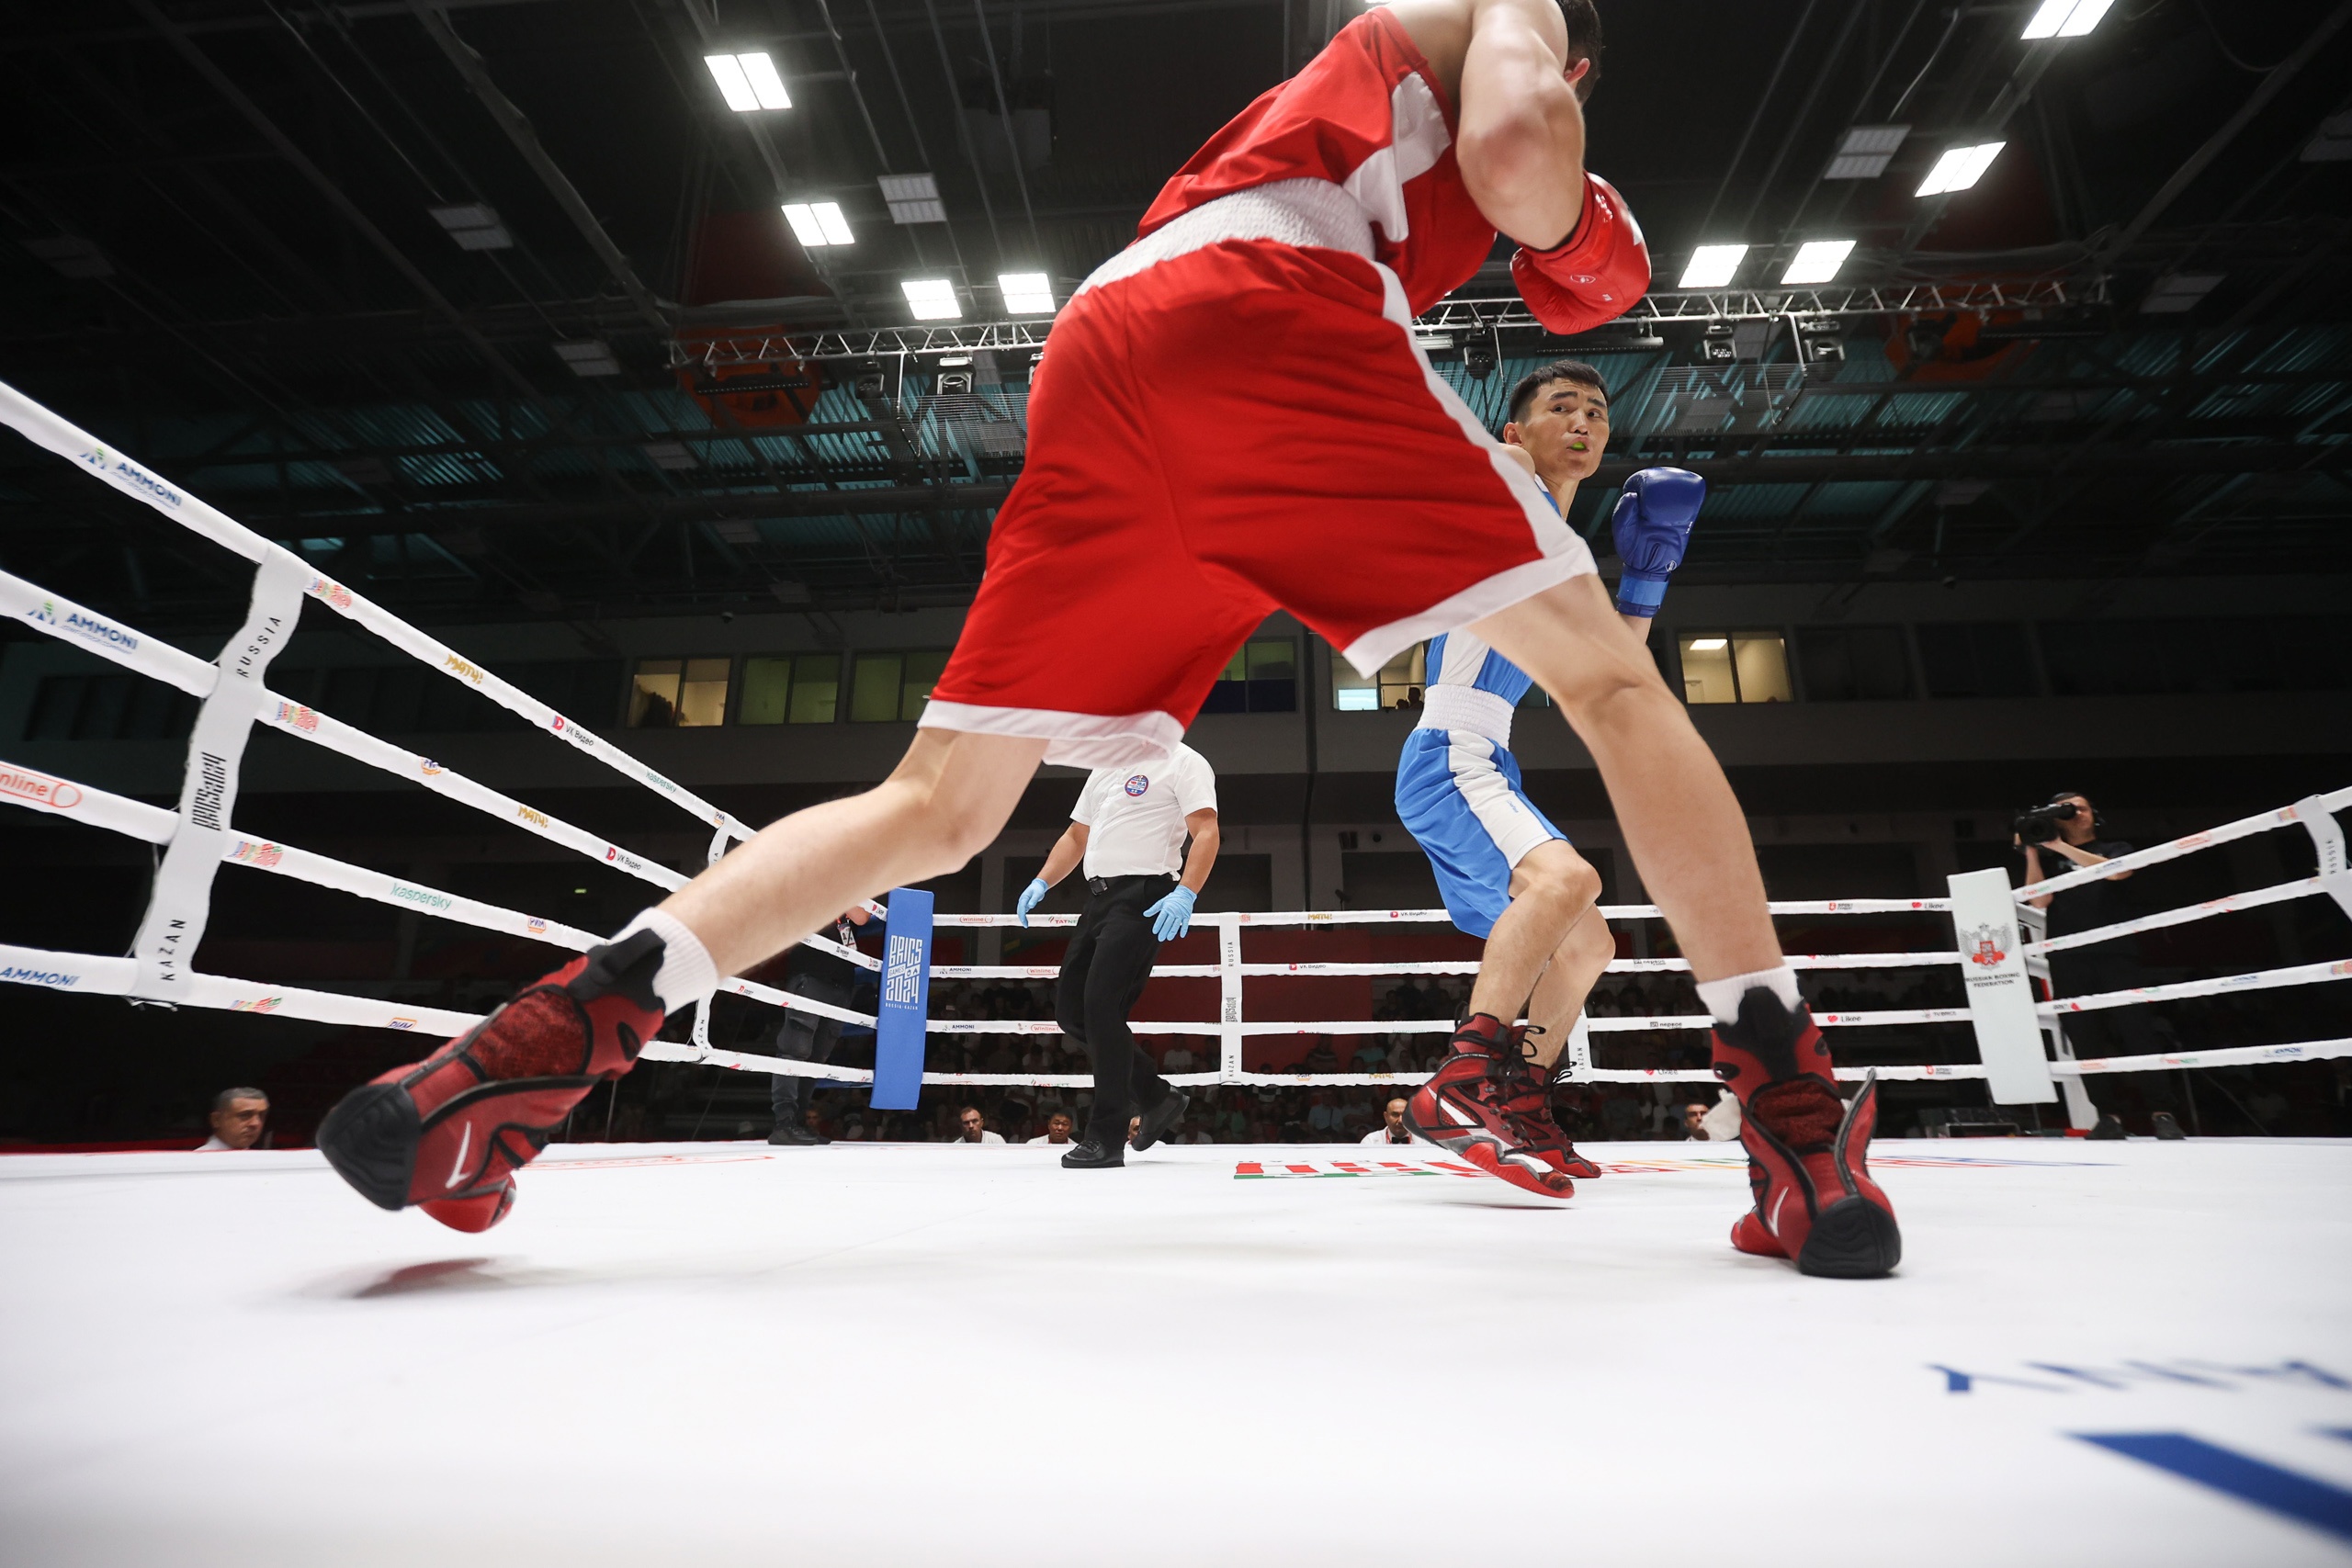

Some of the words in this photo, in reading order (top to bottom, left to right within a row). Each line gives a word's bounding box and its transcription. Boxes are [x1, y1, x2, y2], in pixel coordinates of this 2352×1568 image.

[117, 462, 183, 506] AMMONI
[65, 613, 138, 650] AMMONI
[237, 616, 282, 678] RUSSIA
[574, 728, 594, 748] Видео
[645, 771, 677, 793] kaspersky
[626, 856, 641, 871] Видео
[390, 882, 452, 911] kaspersky
[160, 919, 187, 981] KAZAN
[888, 934, 923, 967] BRICS
[0, 966, 80, 987] AMMONI
[888, 965, 905, 976] GAMES
[886, 975, 920, 1004] 2024
